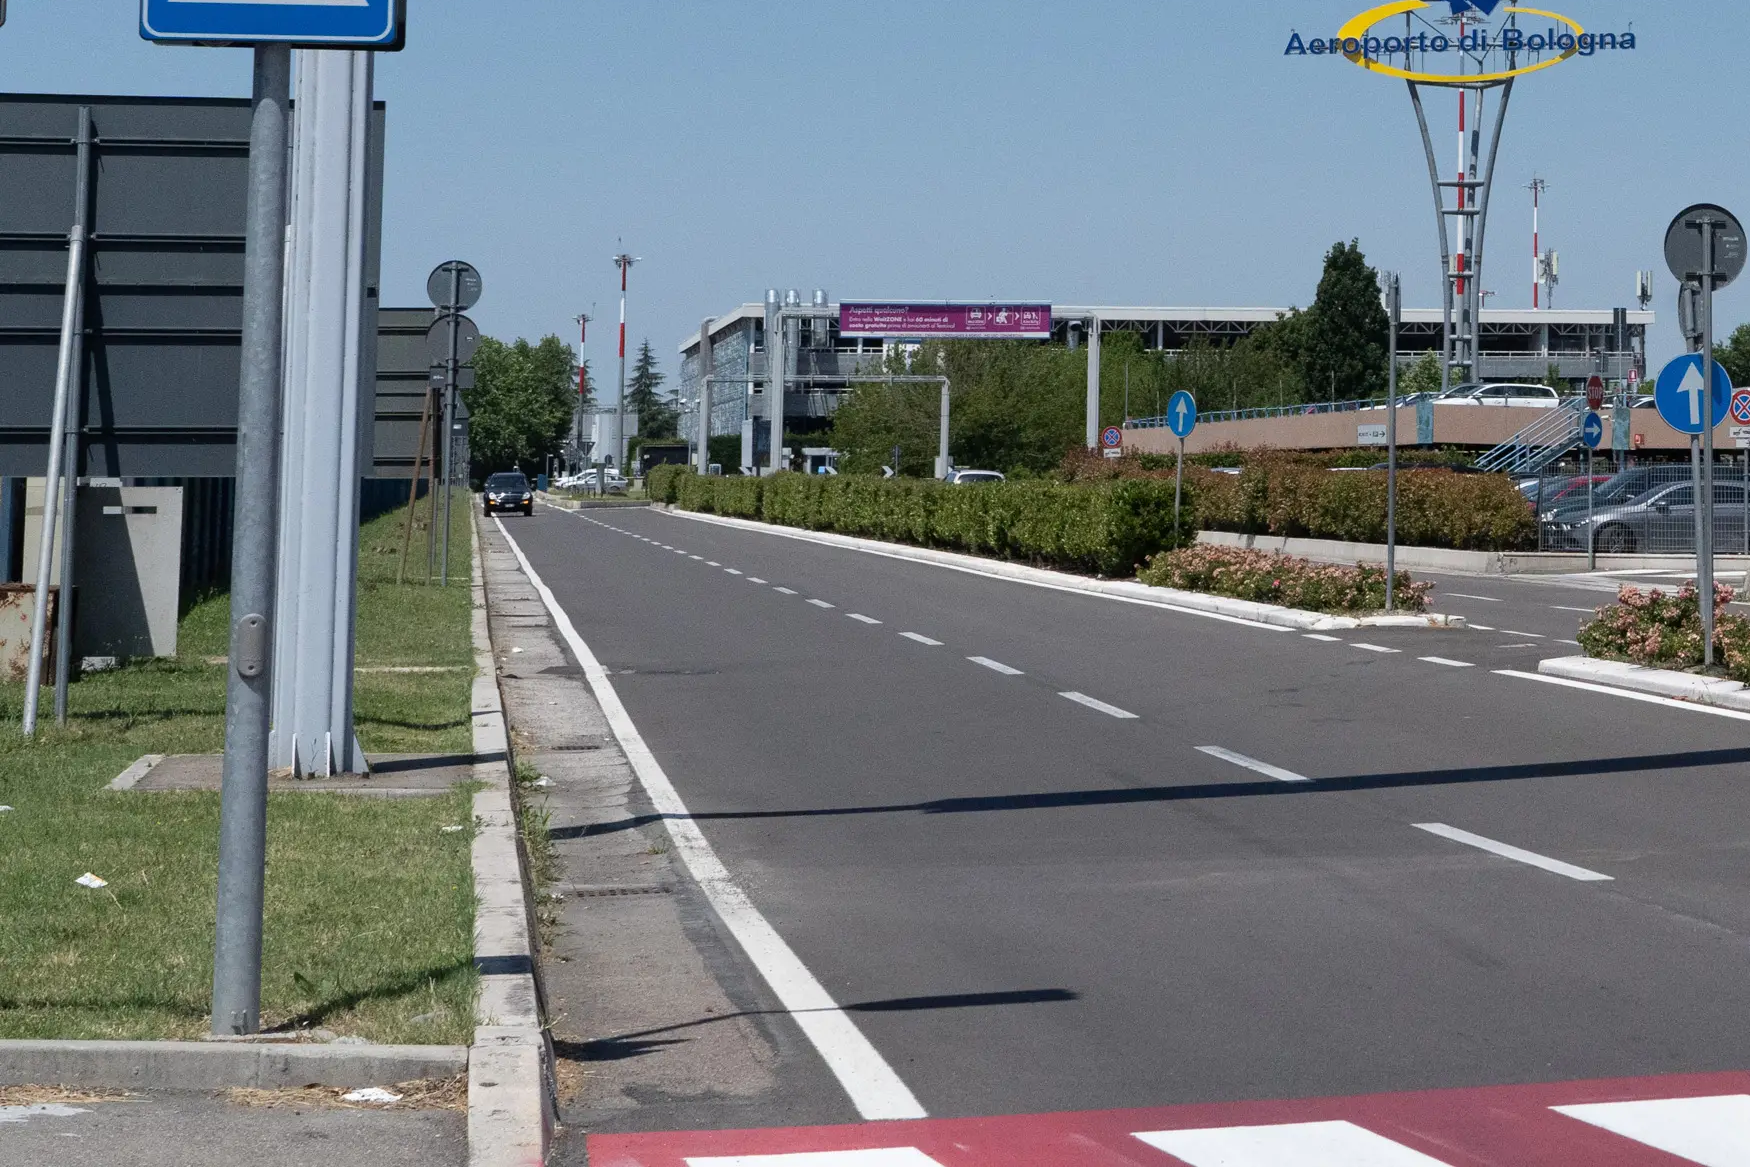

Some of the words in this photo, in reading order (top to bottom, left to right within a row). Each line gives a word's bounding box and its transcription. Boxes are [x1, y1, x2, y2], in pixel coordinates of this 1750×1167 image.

[1284, 31, 1449, 60] Aeroporto
[1460, 28, 1488, 52] di
[1502, 27, 1637, 57] Bologna
[849, 306, 873, 315] Aspetti
[874, 306, 909, 315] qualcuno?
[1588, 387, 1602, 400] STOP
